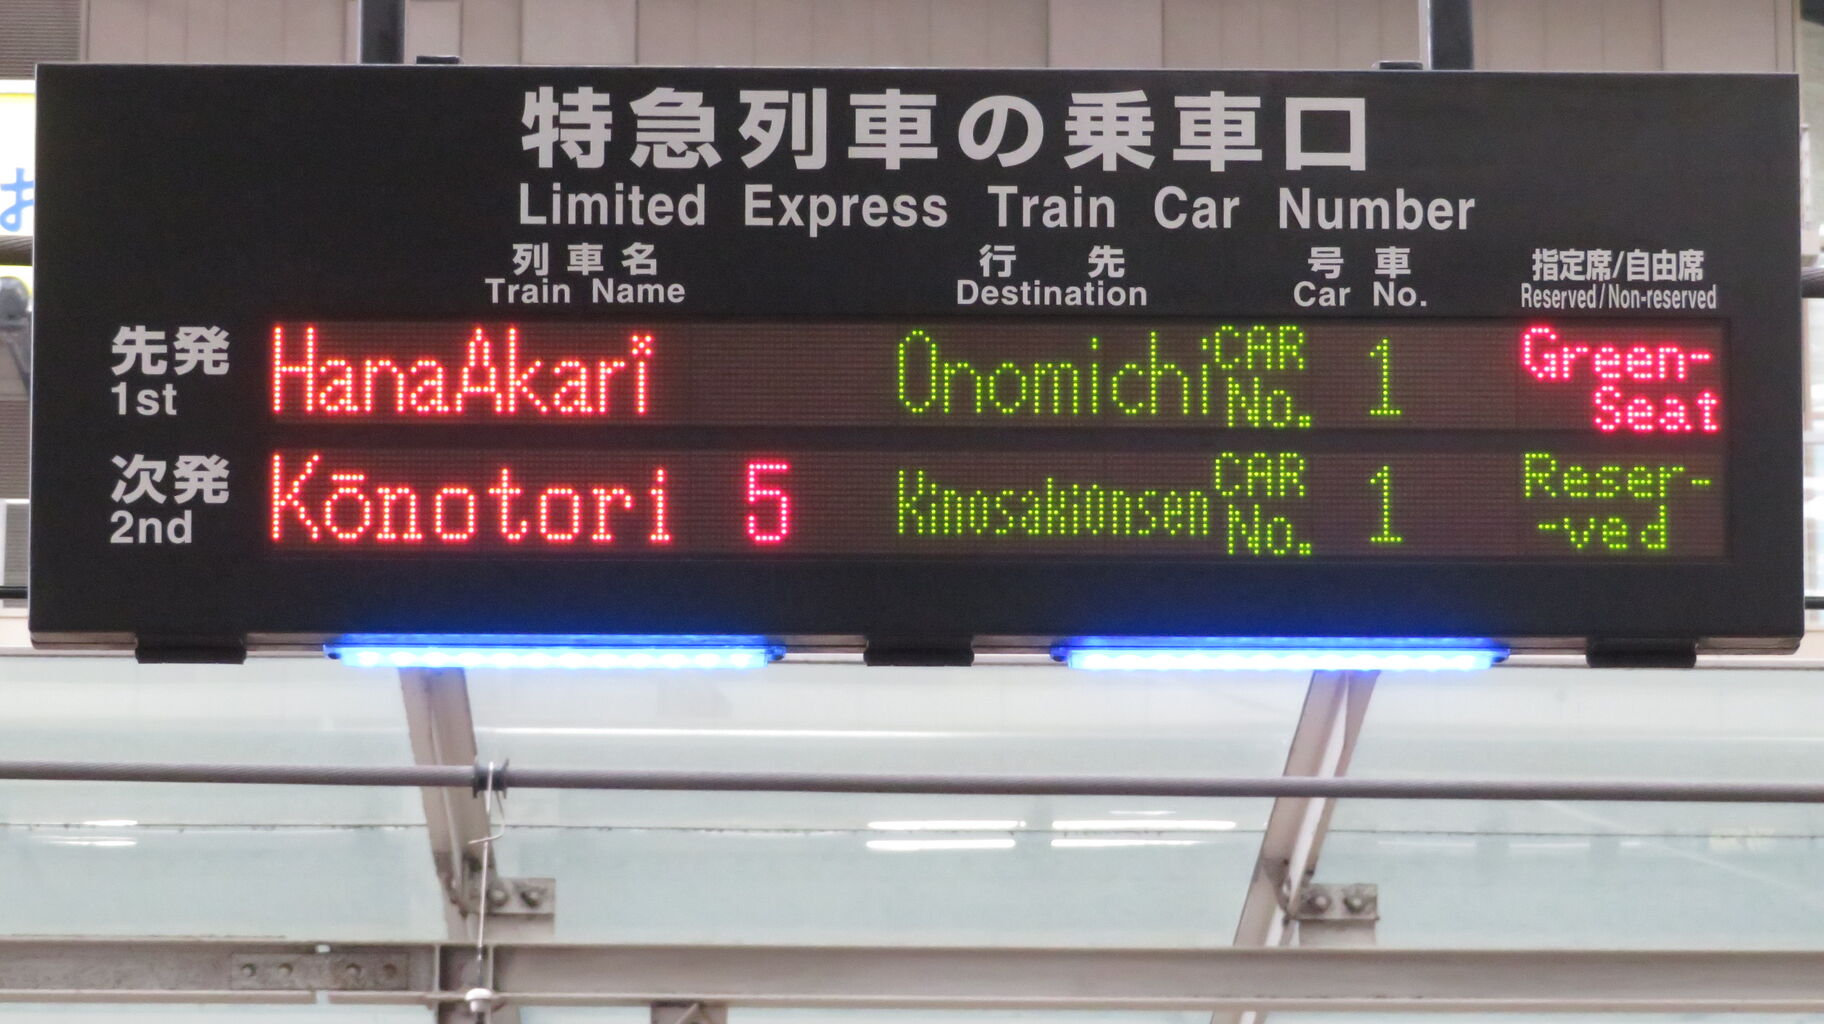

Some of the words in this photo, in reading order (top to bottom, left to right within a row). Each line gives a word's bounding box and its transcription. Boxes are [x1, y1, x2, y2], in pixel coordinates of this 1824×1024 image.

[522, 87, 1365, 172] 特急列車の乗車口
[521, 183, 704, 225] Limited
[745, 184, 947, 237] Express
[988, 186, 1114, 227] Train
[1155, 186, 1239, 228] Car
[1280, 188, 1475, 230] Number
[513, 242, 656, 275] 列車名
[1532, 249, 1704, 281] 指定席/自由席
[485, 278, 570, 303] Train
[593, 279, 685, 303] Name
[958, 280, 1146, 305] Destination
[1294, 281, 1350, 306] Car
[1374, 282, 1426, 306] No.
[112, 326, 229, 375] 先発
[272, 326, 654, 416] HanaAkari
[1215, 325, 1304, 370] CAR
[1521, 326, 1713, 380] Green-
[899, 330, 1208, 415] Onomichi
[1370, 339, 1401, 416] 1
[112, 382, 176, 415] 1st
[1228, 377, 1311, 427] No.
[1592, 384, 1720, 432] Seat
[112, 454, 229, 503] 次発
[1215, 452, 1305, 496] CAR
[1525, 453, 1710, 498] Reser-
[271, 454, 672, 544] Kōnotori
[745, 459, 792, 545] 5
[1370, 466, 1402, 542] 1
[111, 510, 191, 543] 2nd
[1228, 504, 1311, 555] No.
[1538, 505, 1667, 549] -ved
